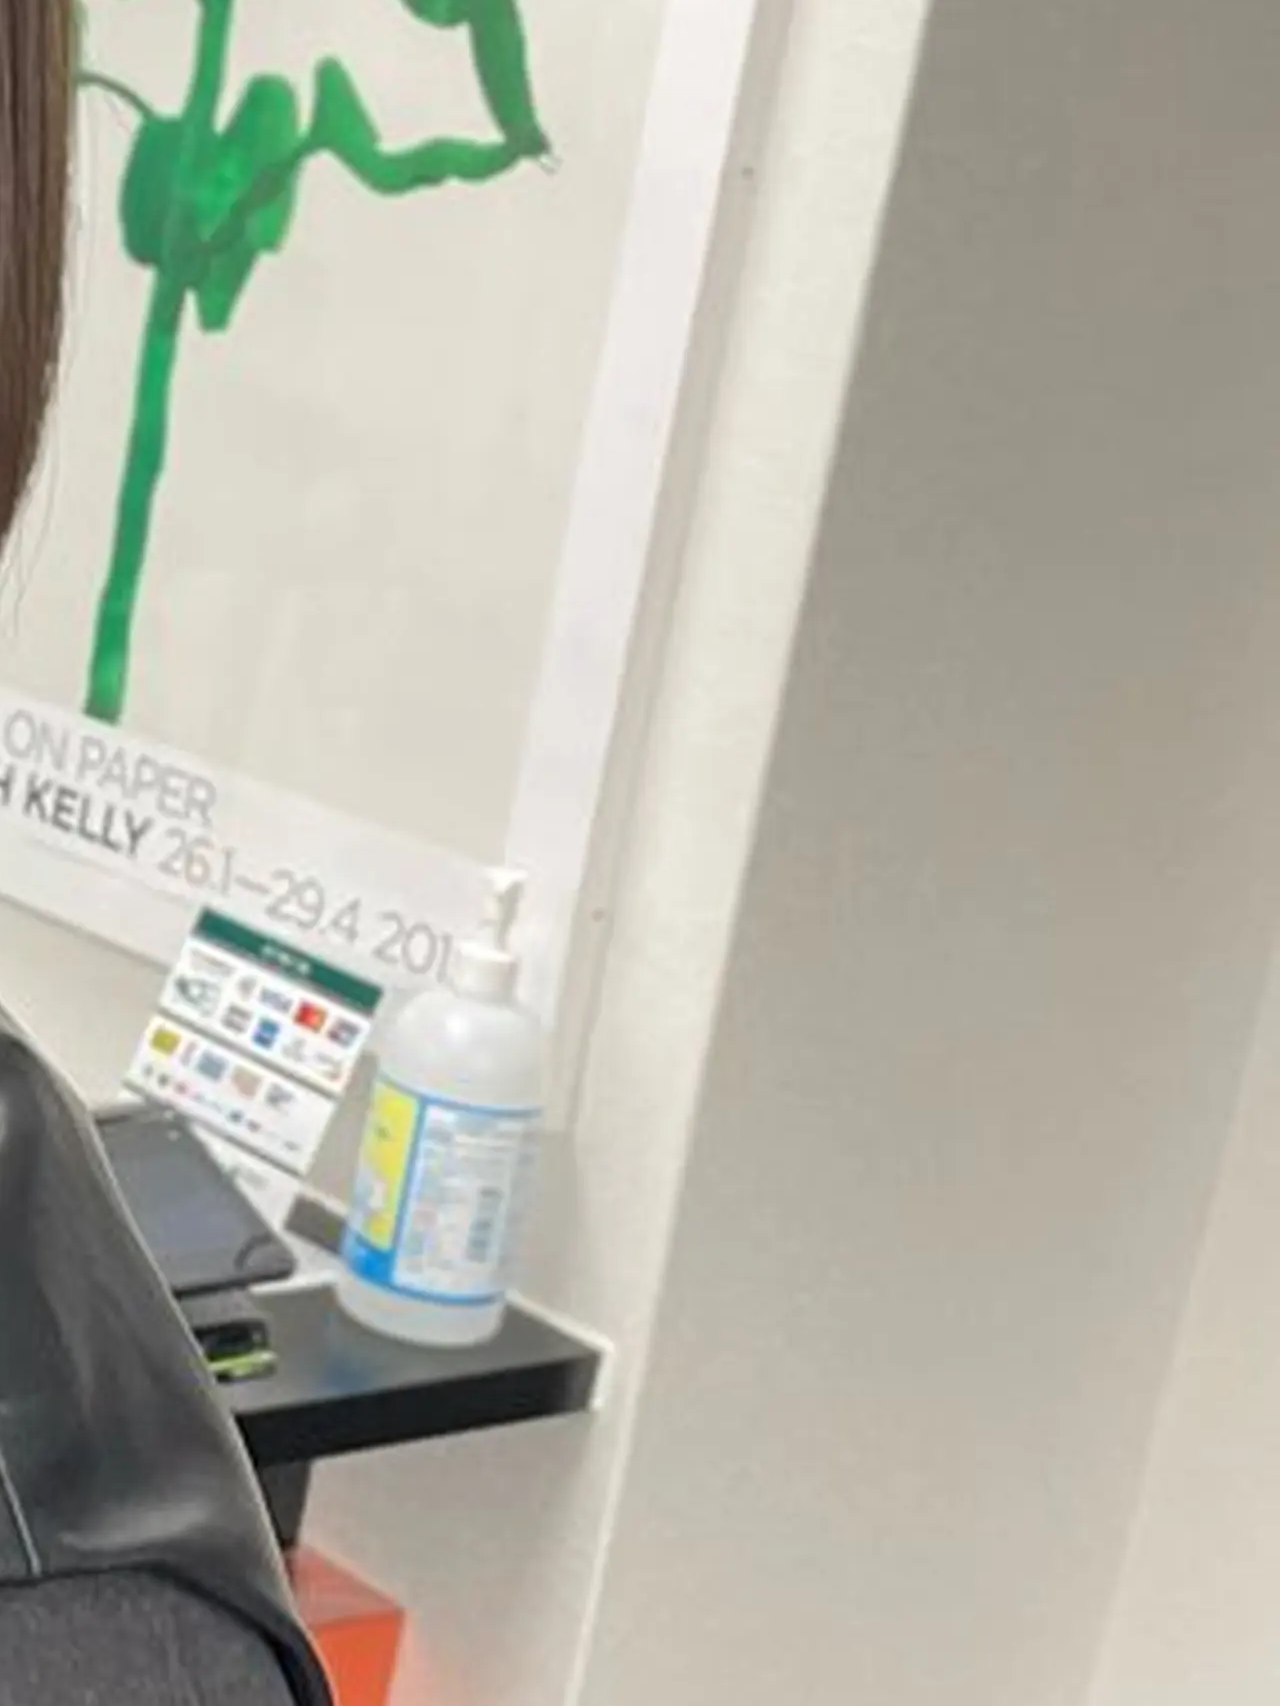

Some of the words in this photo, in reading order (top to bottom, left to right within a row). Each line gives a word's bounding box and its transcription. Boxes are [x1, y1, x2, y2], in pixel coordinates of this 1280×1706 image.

[3, 708, 71, 772] ON
[77, 734, 217, 825] PAPER
[22, 773, 155, 859] KELLY
